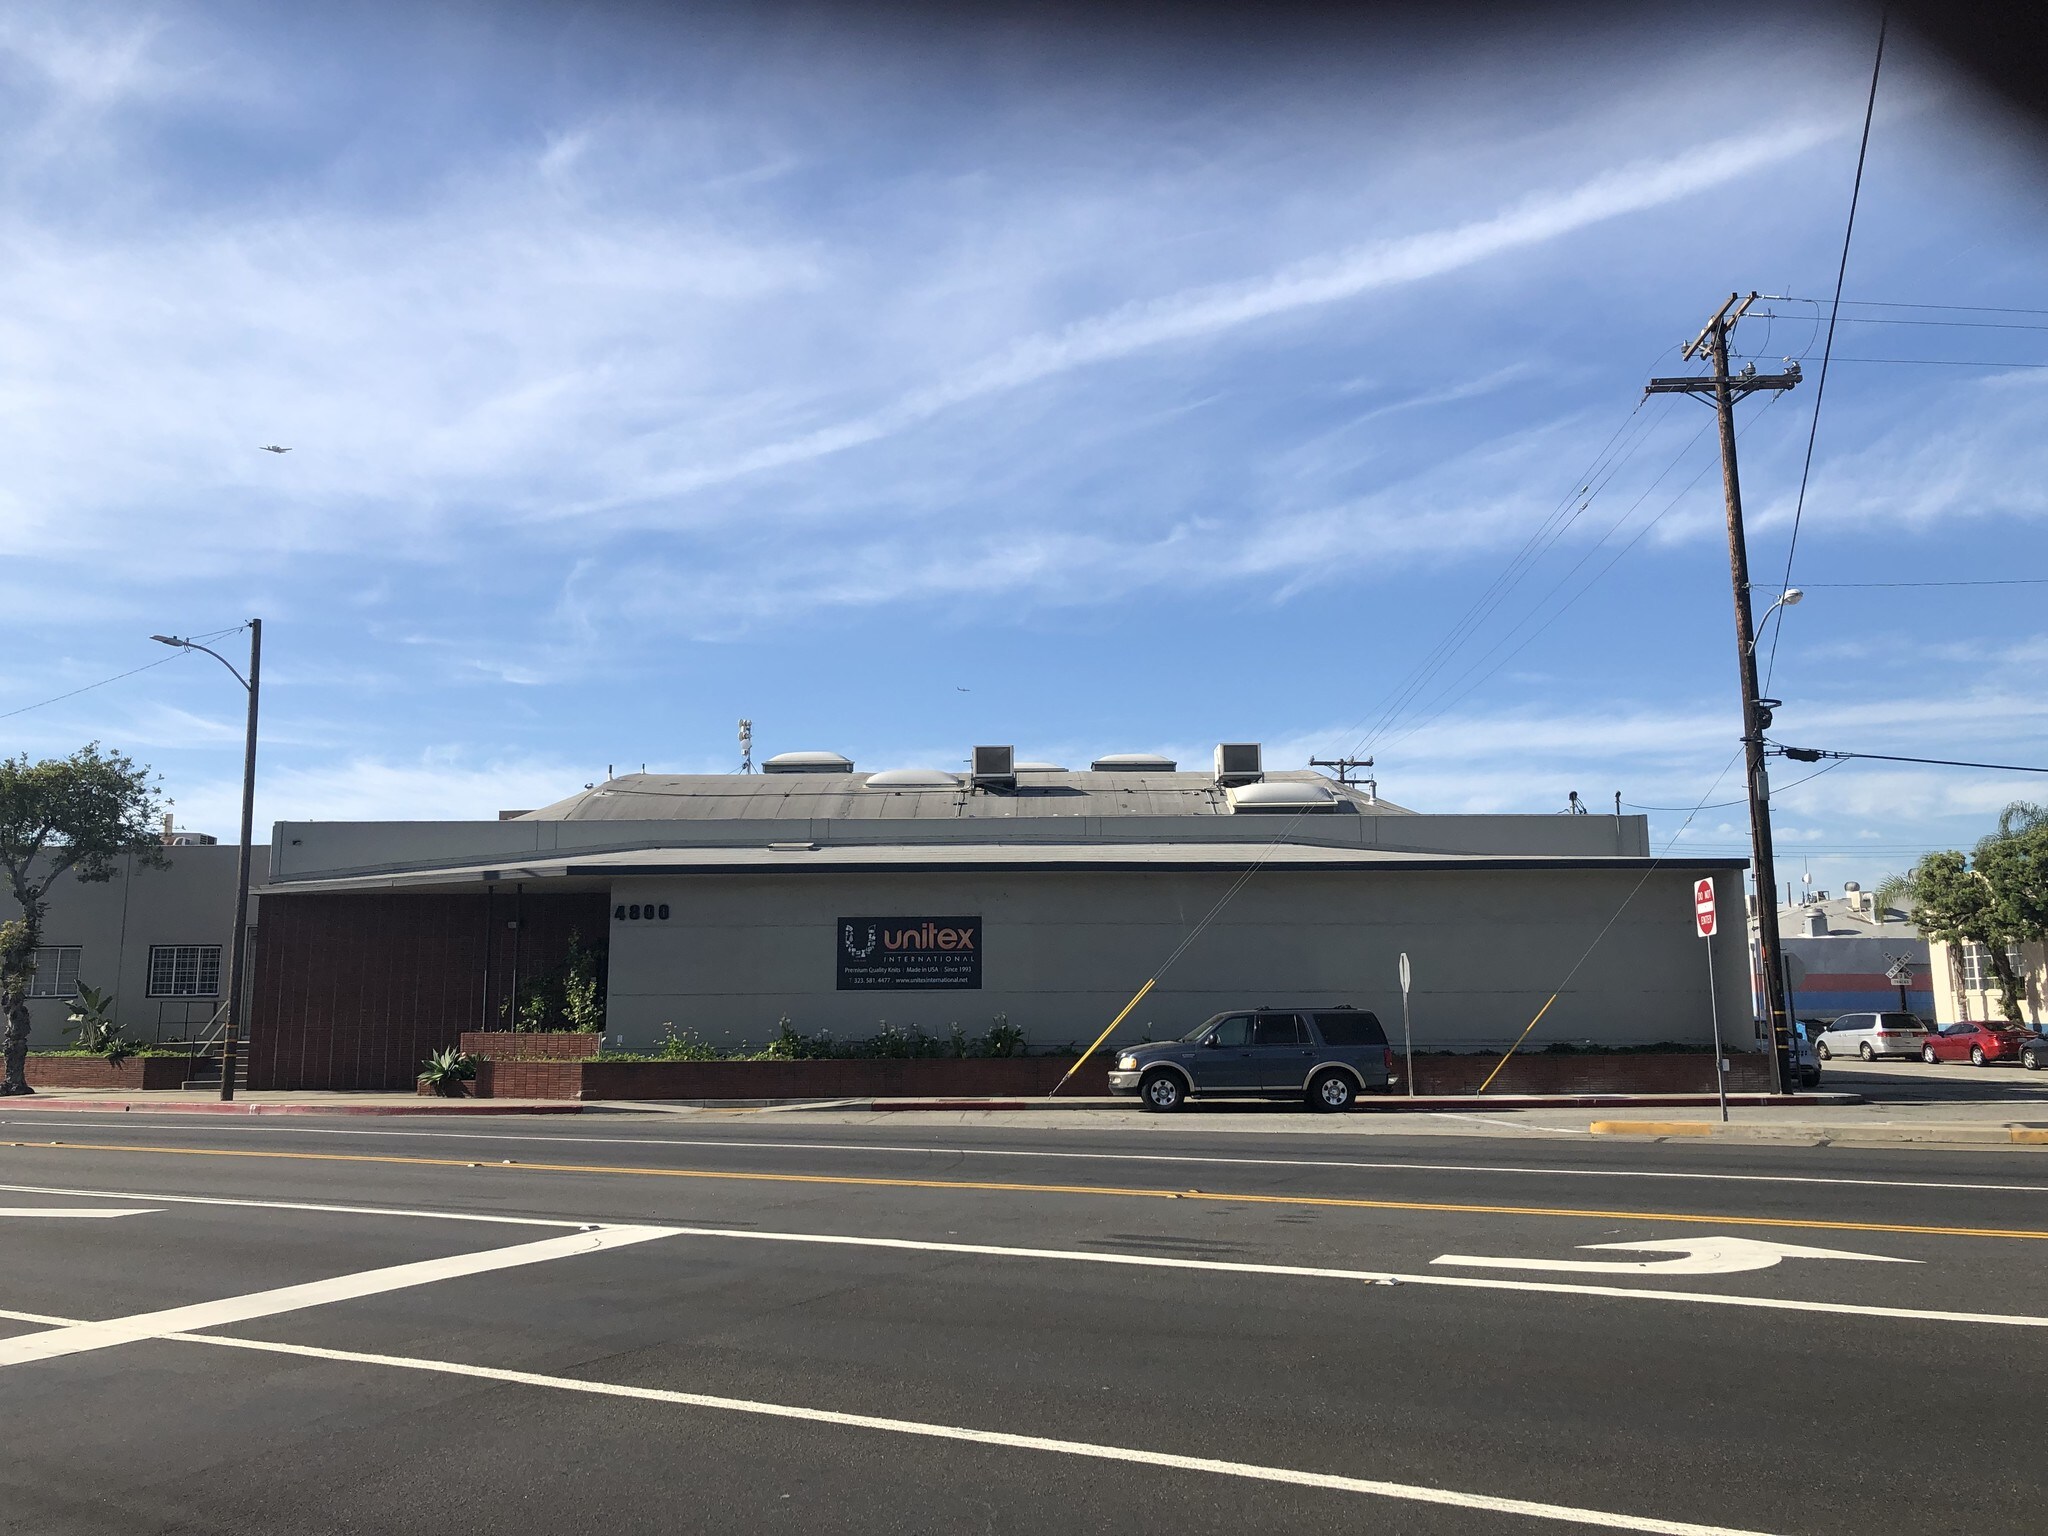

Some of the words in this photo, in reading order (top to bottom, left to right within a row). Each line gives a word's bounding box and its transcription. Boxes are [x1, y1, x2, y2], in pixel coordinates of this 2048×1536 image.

[1698, 892, 1704, 900] DO
[614, 904, 670, 921] 4800
[1700, 914, 1712, 925] ENTER
[884, 922, 975, 950] unitex
[883, 955, 975, 963] INTERNATIONAL
[869, 966, 888, 974] Quality
[1886, 952, 1912, 978] CROSSING
